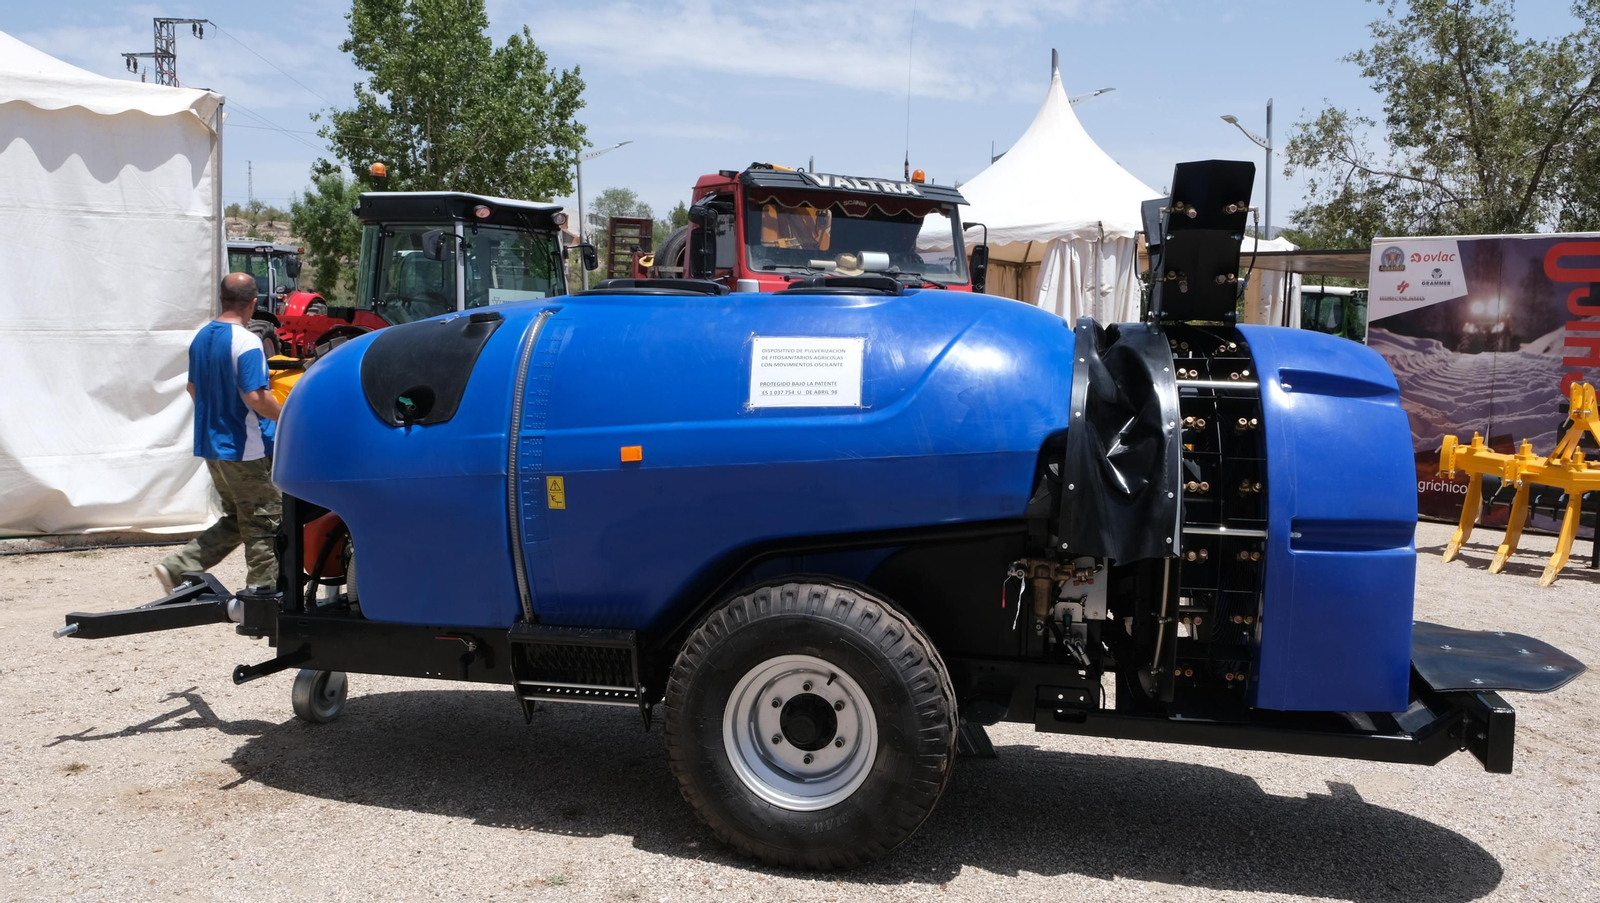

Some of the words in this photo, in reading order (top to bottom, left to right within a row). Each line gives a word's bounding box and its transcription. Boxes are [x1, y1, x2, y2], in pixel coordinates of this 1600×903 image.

[807, 173, 921, 196] VALTRA
[842, 200, 868, 208] SCANIA
[1423, 251, 1456, 262] ovlac
